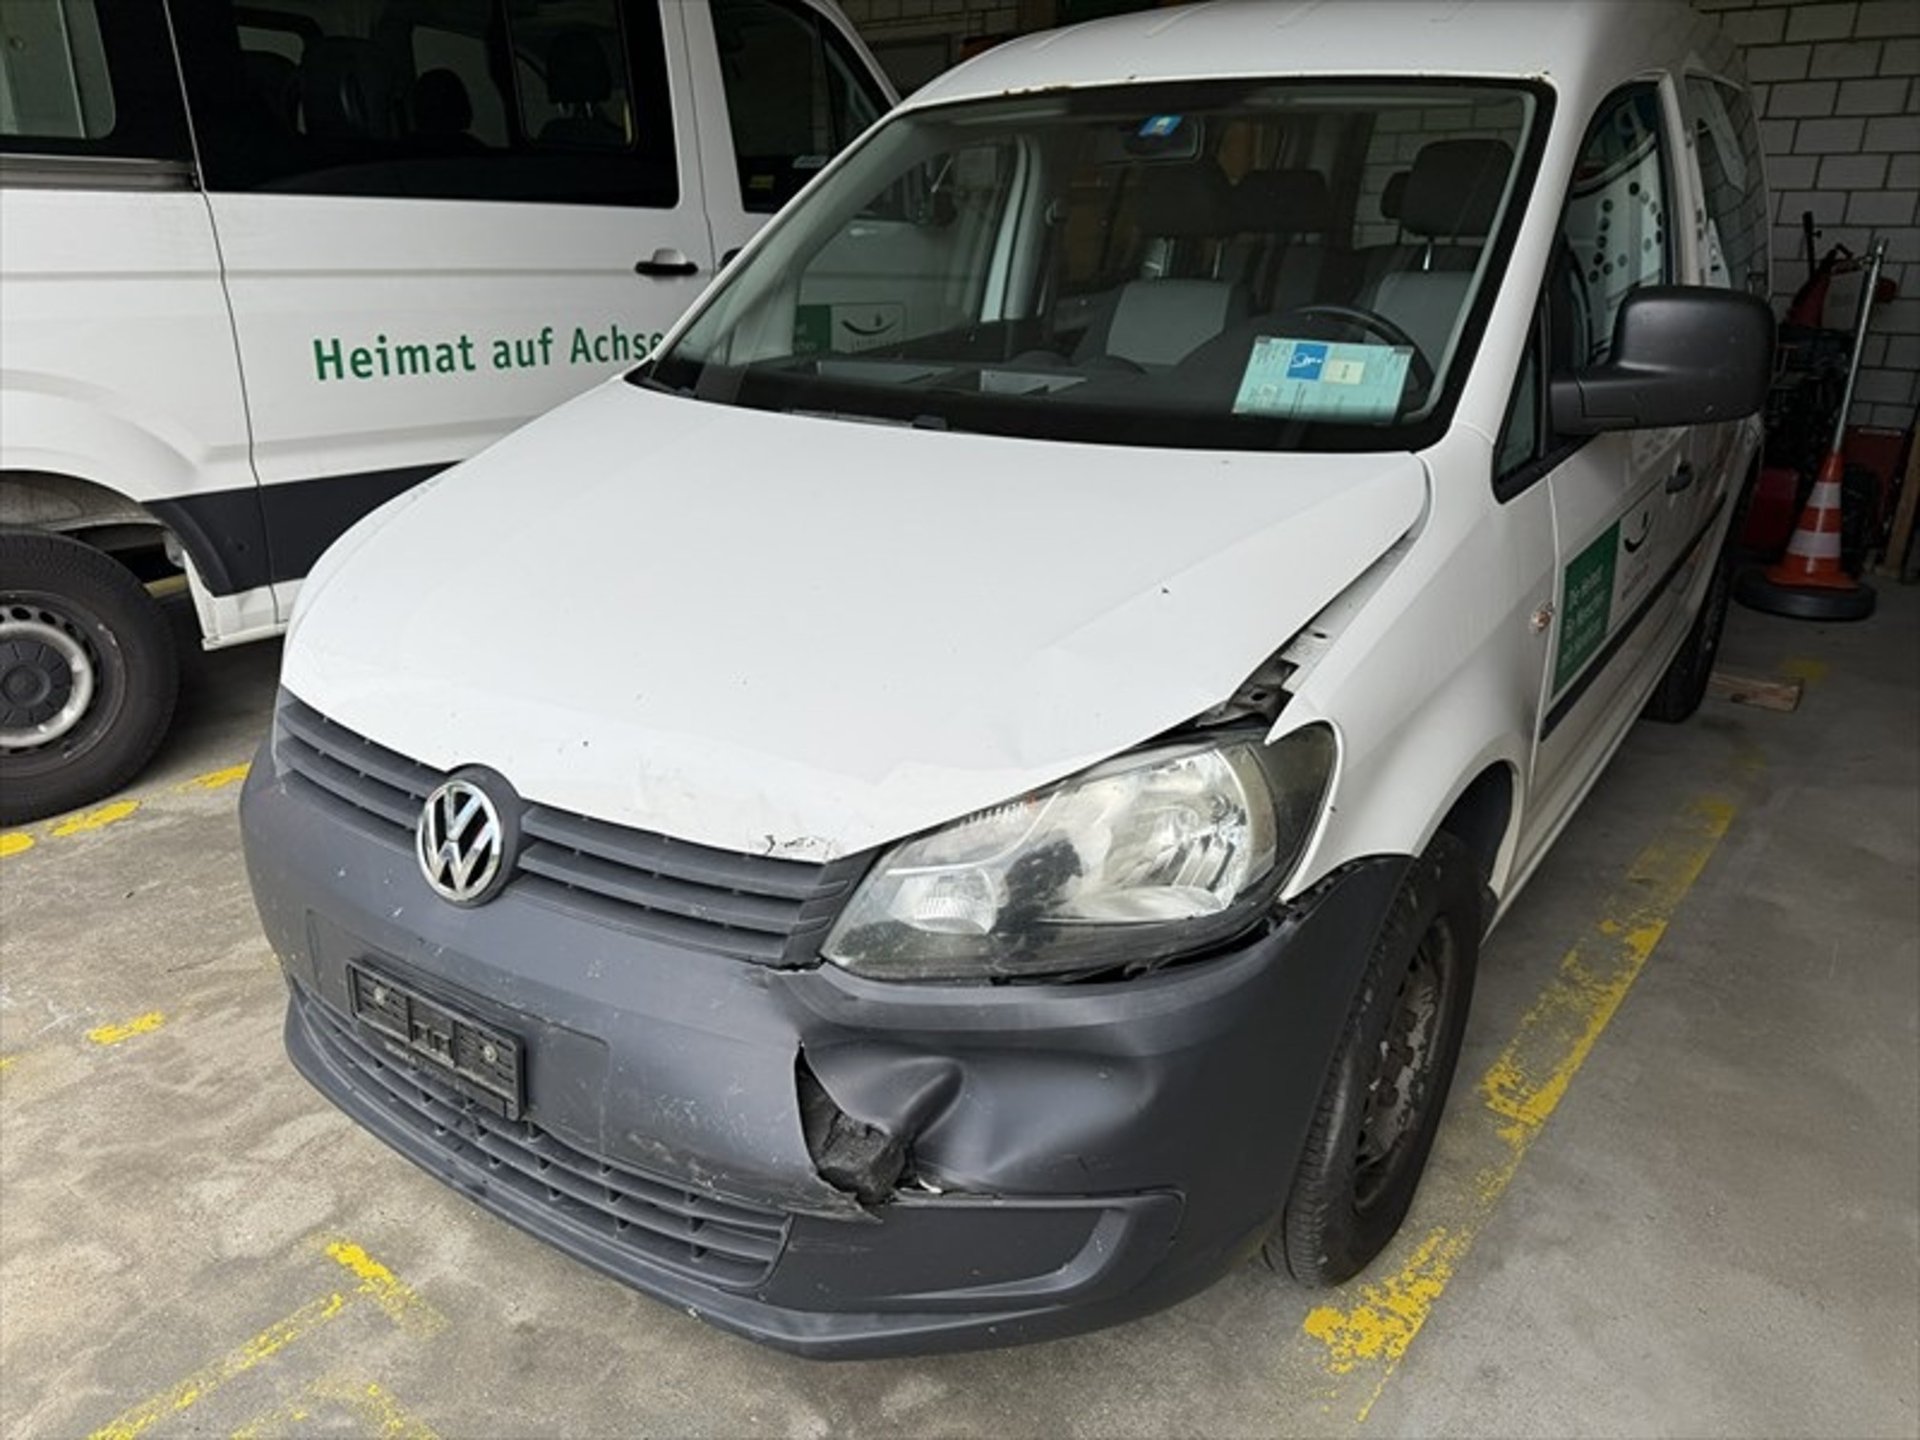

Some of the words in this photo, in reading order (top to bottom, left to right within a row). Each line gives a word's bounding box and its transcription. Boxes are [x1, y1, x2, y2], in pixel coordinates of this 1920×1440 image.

[313, 335, 475, 380] Heimat
[493, 327, 553, 369] auf
[420, 784, 498, 896] VW
